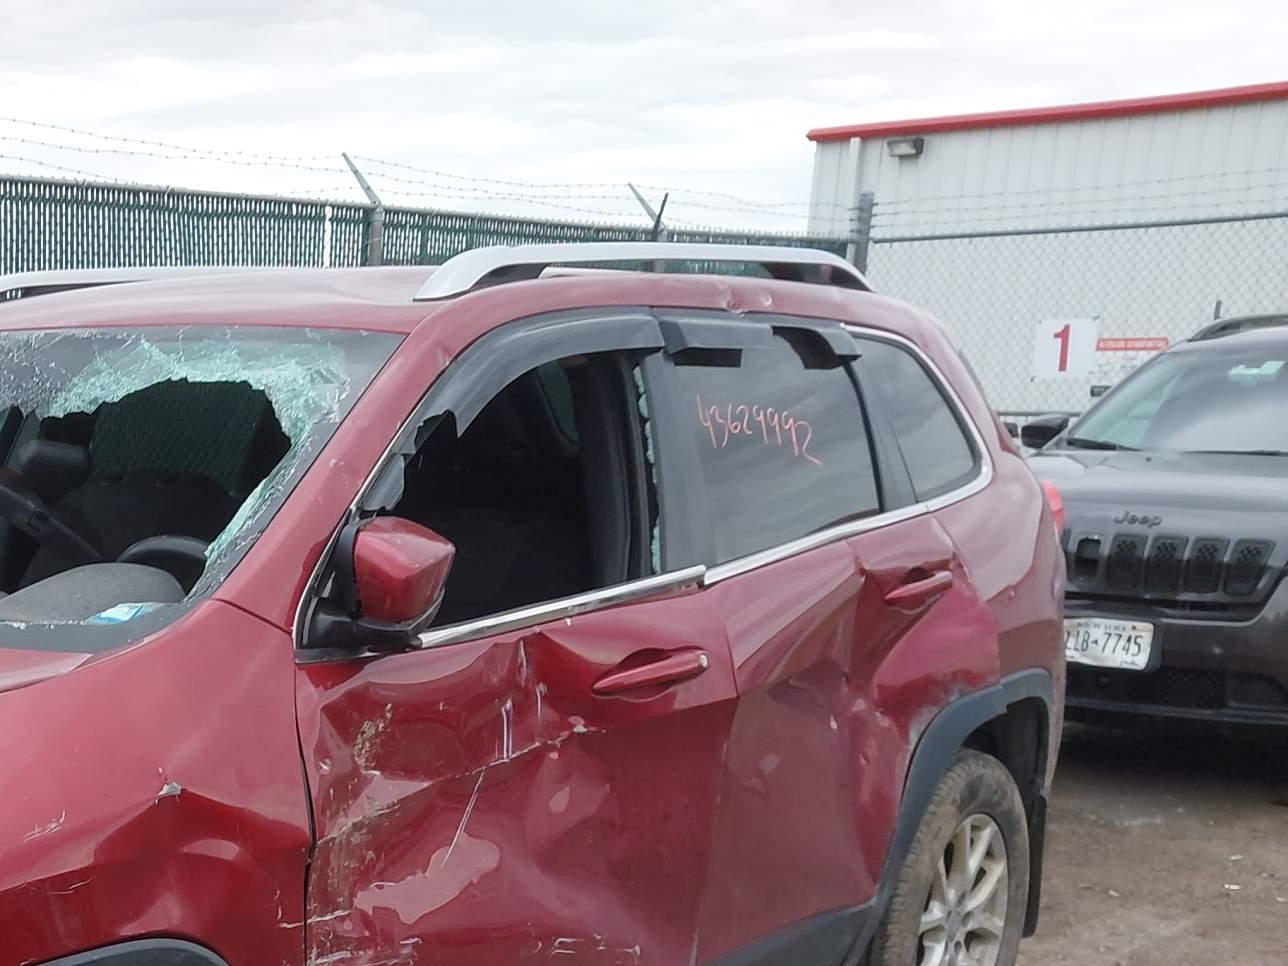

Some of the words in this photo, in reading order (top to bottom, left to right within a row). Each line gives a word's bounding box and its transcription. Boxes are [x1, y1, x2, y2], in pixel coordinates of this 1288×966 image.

[1053, 324, 1071, 372] 1
[696, 393, 823, 465] 43629992
[1113, 511, 1163, 528] Jeep
